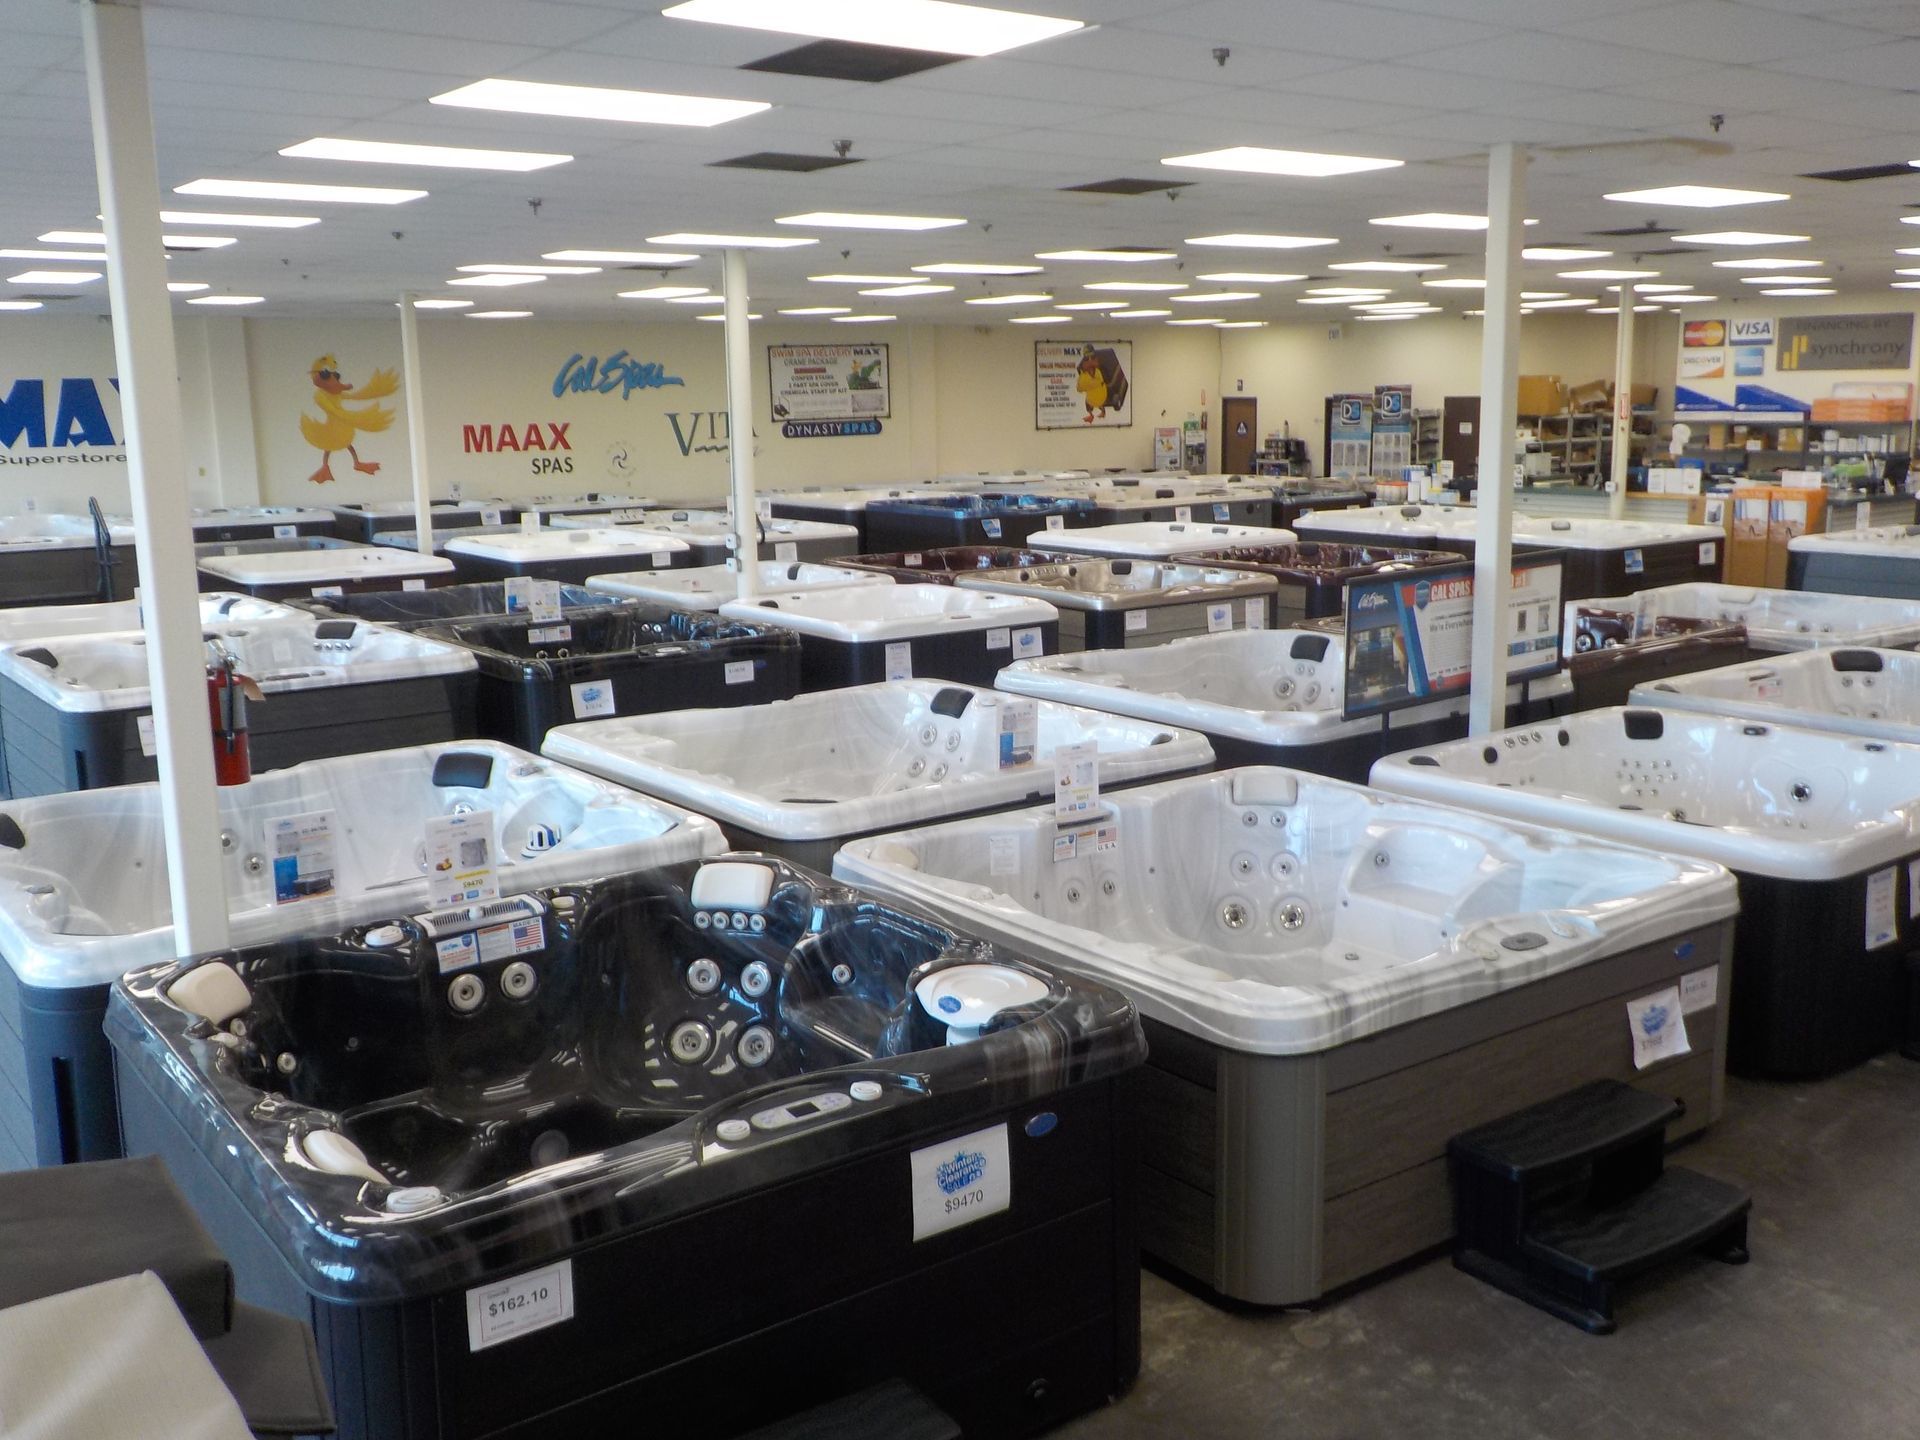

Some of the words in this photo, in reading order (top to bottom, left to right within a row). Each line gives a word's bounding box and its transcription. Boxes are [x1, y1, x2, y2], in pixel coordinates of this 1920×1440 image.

[1735, 321, 1771, 335] VISA
[853, 348, 881, 357] MAX
[1063, 348, 1082, 356] MAX
[1812, 339, 1906, 359] synchrony
[463, 422, 573, 453] MAAX
[664, 411, 759, 457] VIT
[787, 423, 842, 436] DYNASTY
[843, 422, 877, 434] SPAS
[532, 457, 574, 475] SPAS
[1431, 583, 1448, 601] CAL
[1449, 579, 1472, 599] SPAS
[944, 1189, 984, 1215] $9470
[489, 1287, 548, 1318] $162.10
